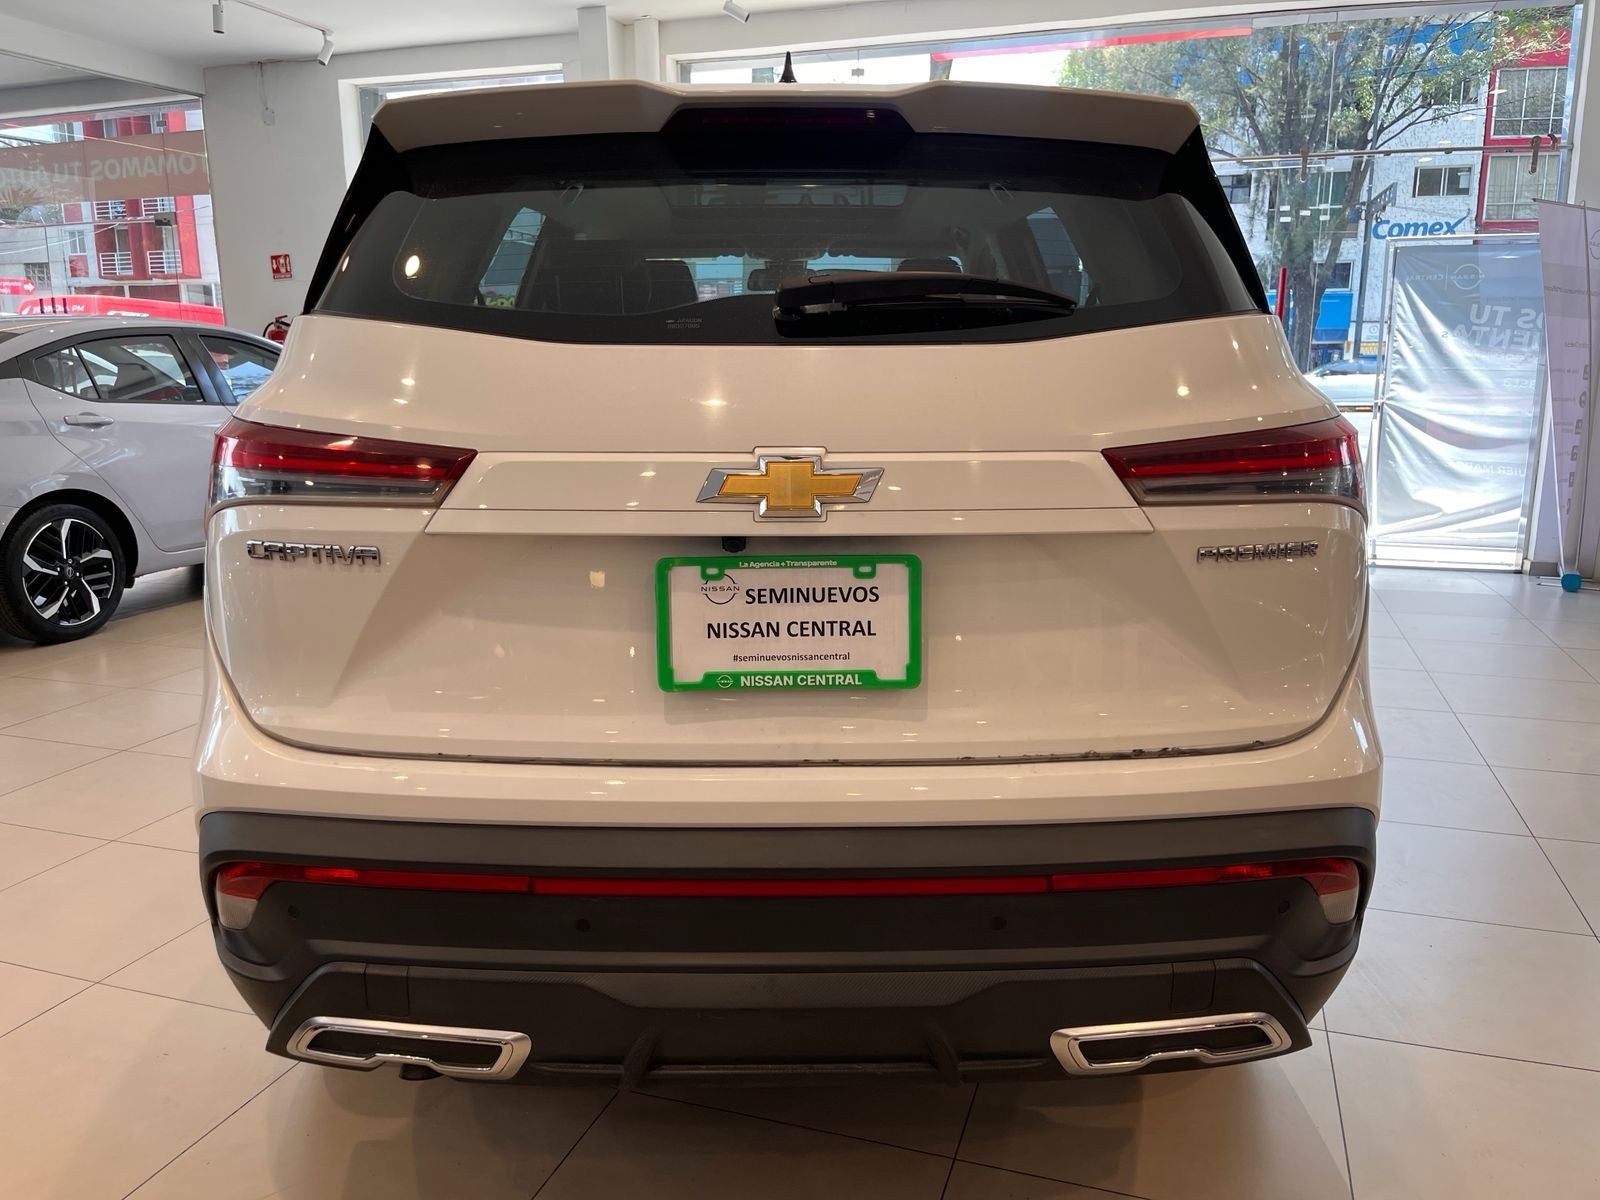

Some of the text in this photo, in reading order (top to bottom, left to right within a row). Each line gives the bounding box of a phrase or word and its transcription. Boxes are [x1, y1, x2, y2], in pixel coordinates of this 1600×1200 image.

[1372, 208, 1470, 240] Comex
[247, 539, 381, 566] CAPTIVA
[1197, 540, 1319, 563] PREMIER
[745, 586, 880, 605] SEMINUEVOS
[707, 620, 877, 639] NISSAN CENTRAL
[732, 652, 851, 662] #seminuevosnissancentral
[740, 675, 793, 688] NISSAN
[797, 673, 863, 686] CENTRAL
